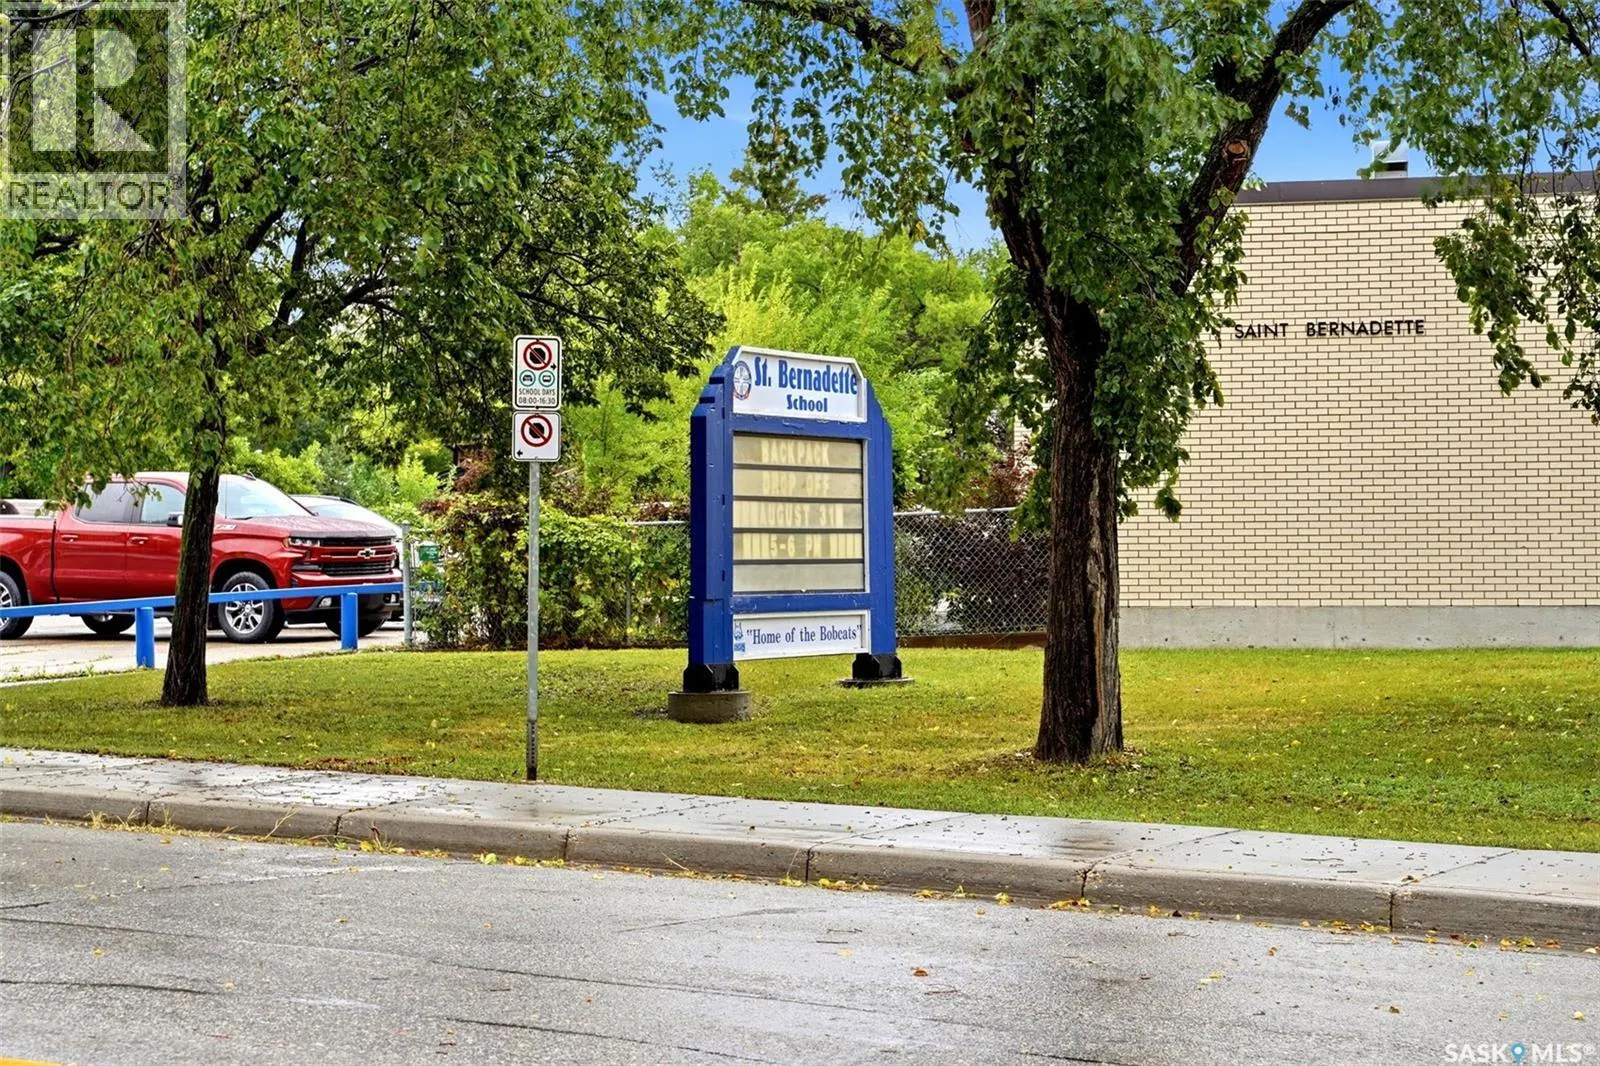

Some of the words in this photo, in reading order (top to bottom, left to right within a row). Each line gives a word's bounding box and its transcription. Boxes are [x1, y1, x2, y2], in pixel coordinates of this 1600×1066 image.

[1234, 323, 1289, 339] SAINT
[1306, 320, 1425, 337] BERNADETTE
[754, 356, 772, 387] St.
[778, 359, 858, 395] Bernadette
[518, 388, 540, 396] SCHOOL
[542, 388, 556, 396] DAYS
[786, 394, 828, 412] School
[760, 502, 810, 528] AUGUST
[770, 533, 795, 558] 5-6
[805, 533, 822, 558] PM
[785, 627, 796, 643] of
[800, 627, 816, 642] the
